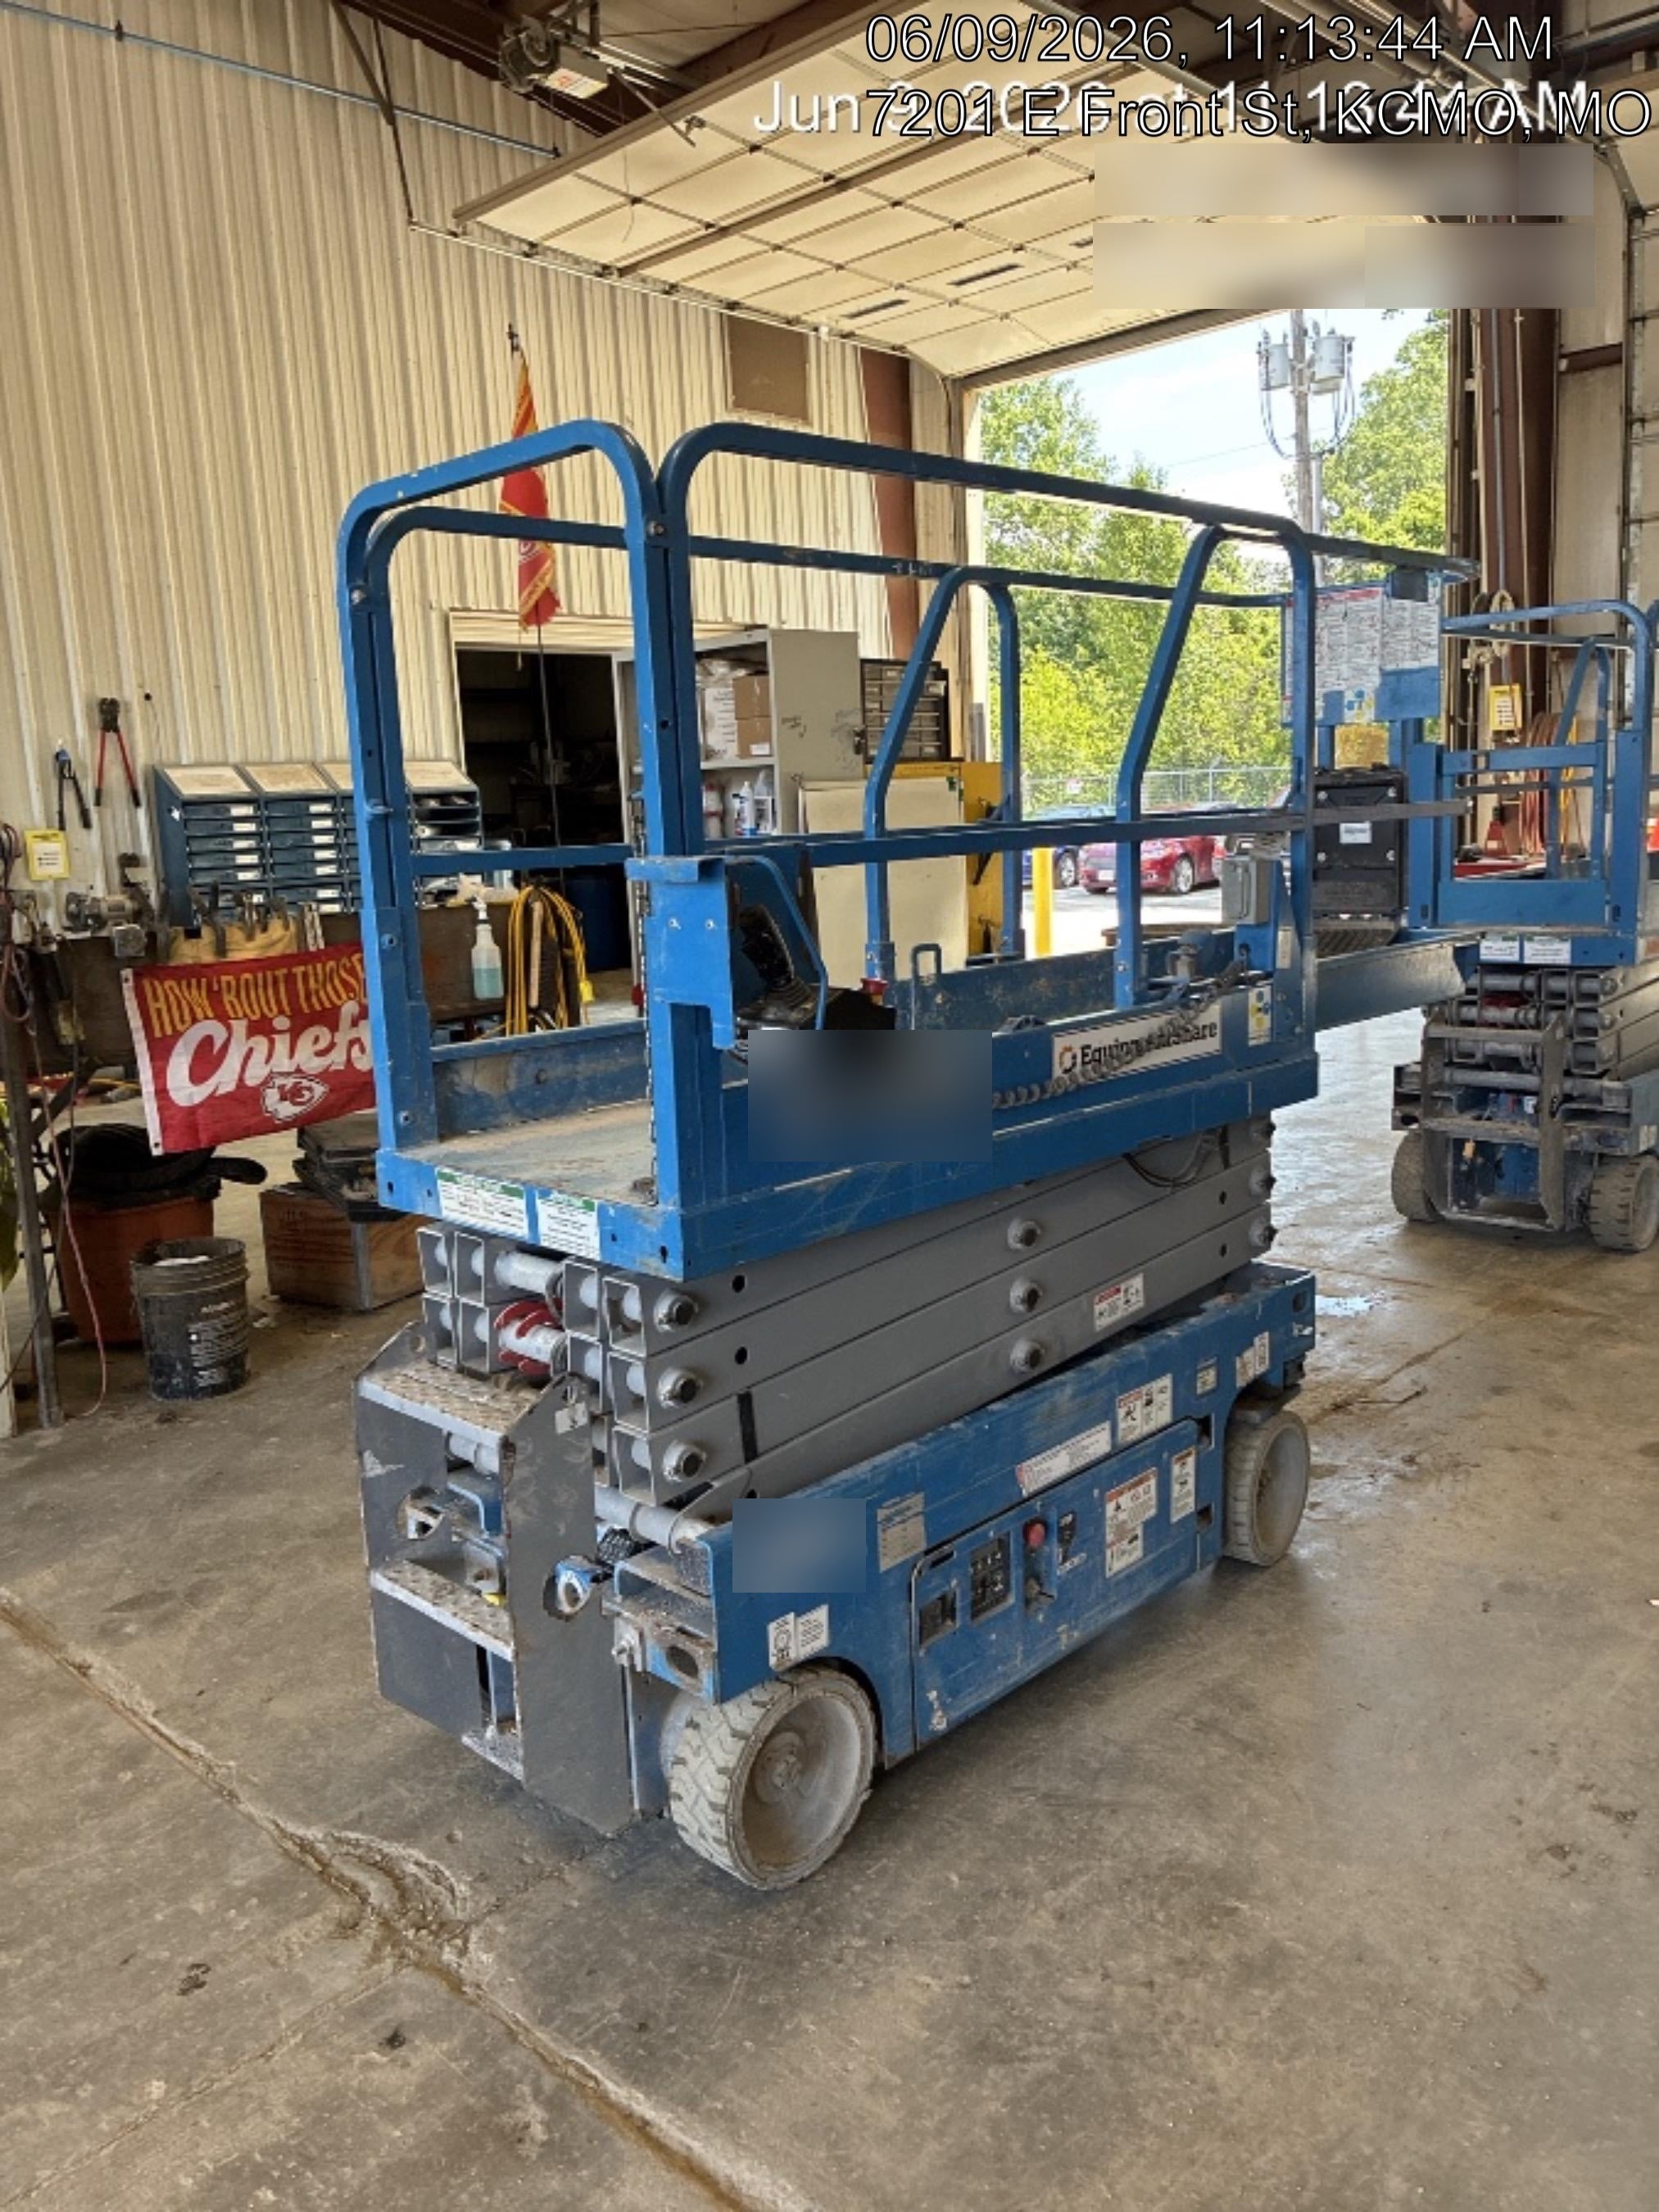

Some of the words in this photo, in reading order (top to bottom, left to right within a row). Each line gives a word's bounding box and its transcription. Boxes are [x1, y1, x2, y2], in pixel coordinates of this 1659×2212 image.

[143, 977, 215, 1038] HOW
[166, 999, 374, 1107] Chiefs
[1081, 1020, 1217, 1067] EquipSare
